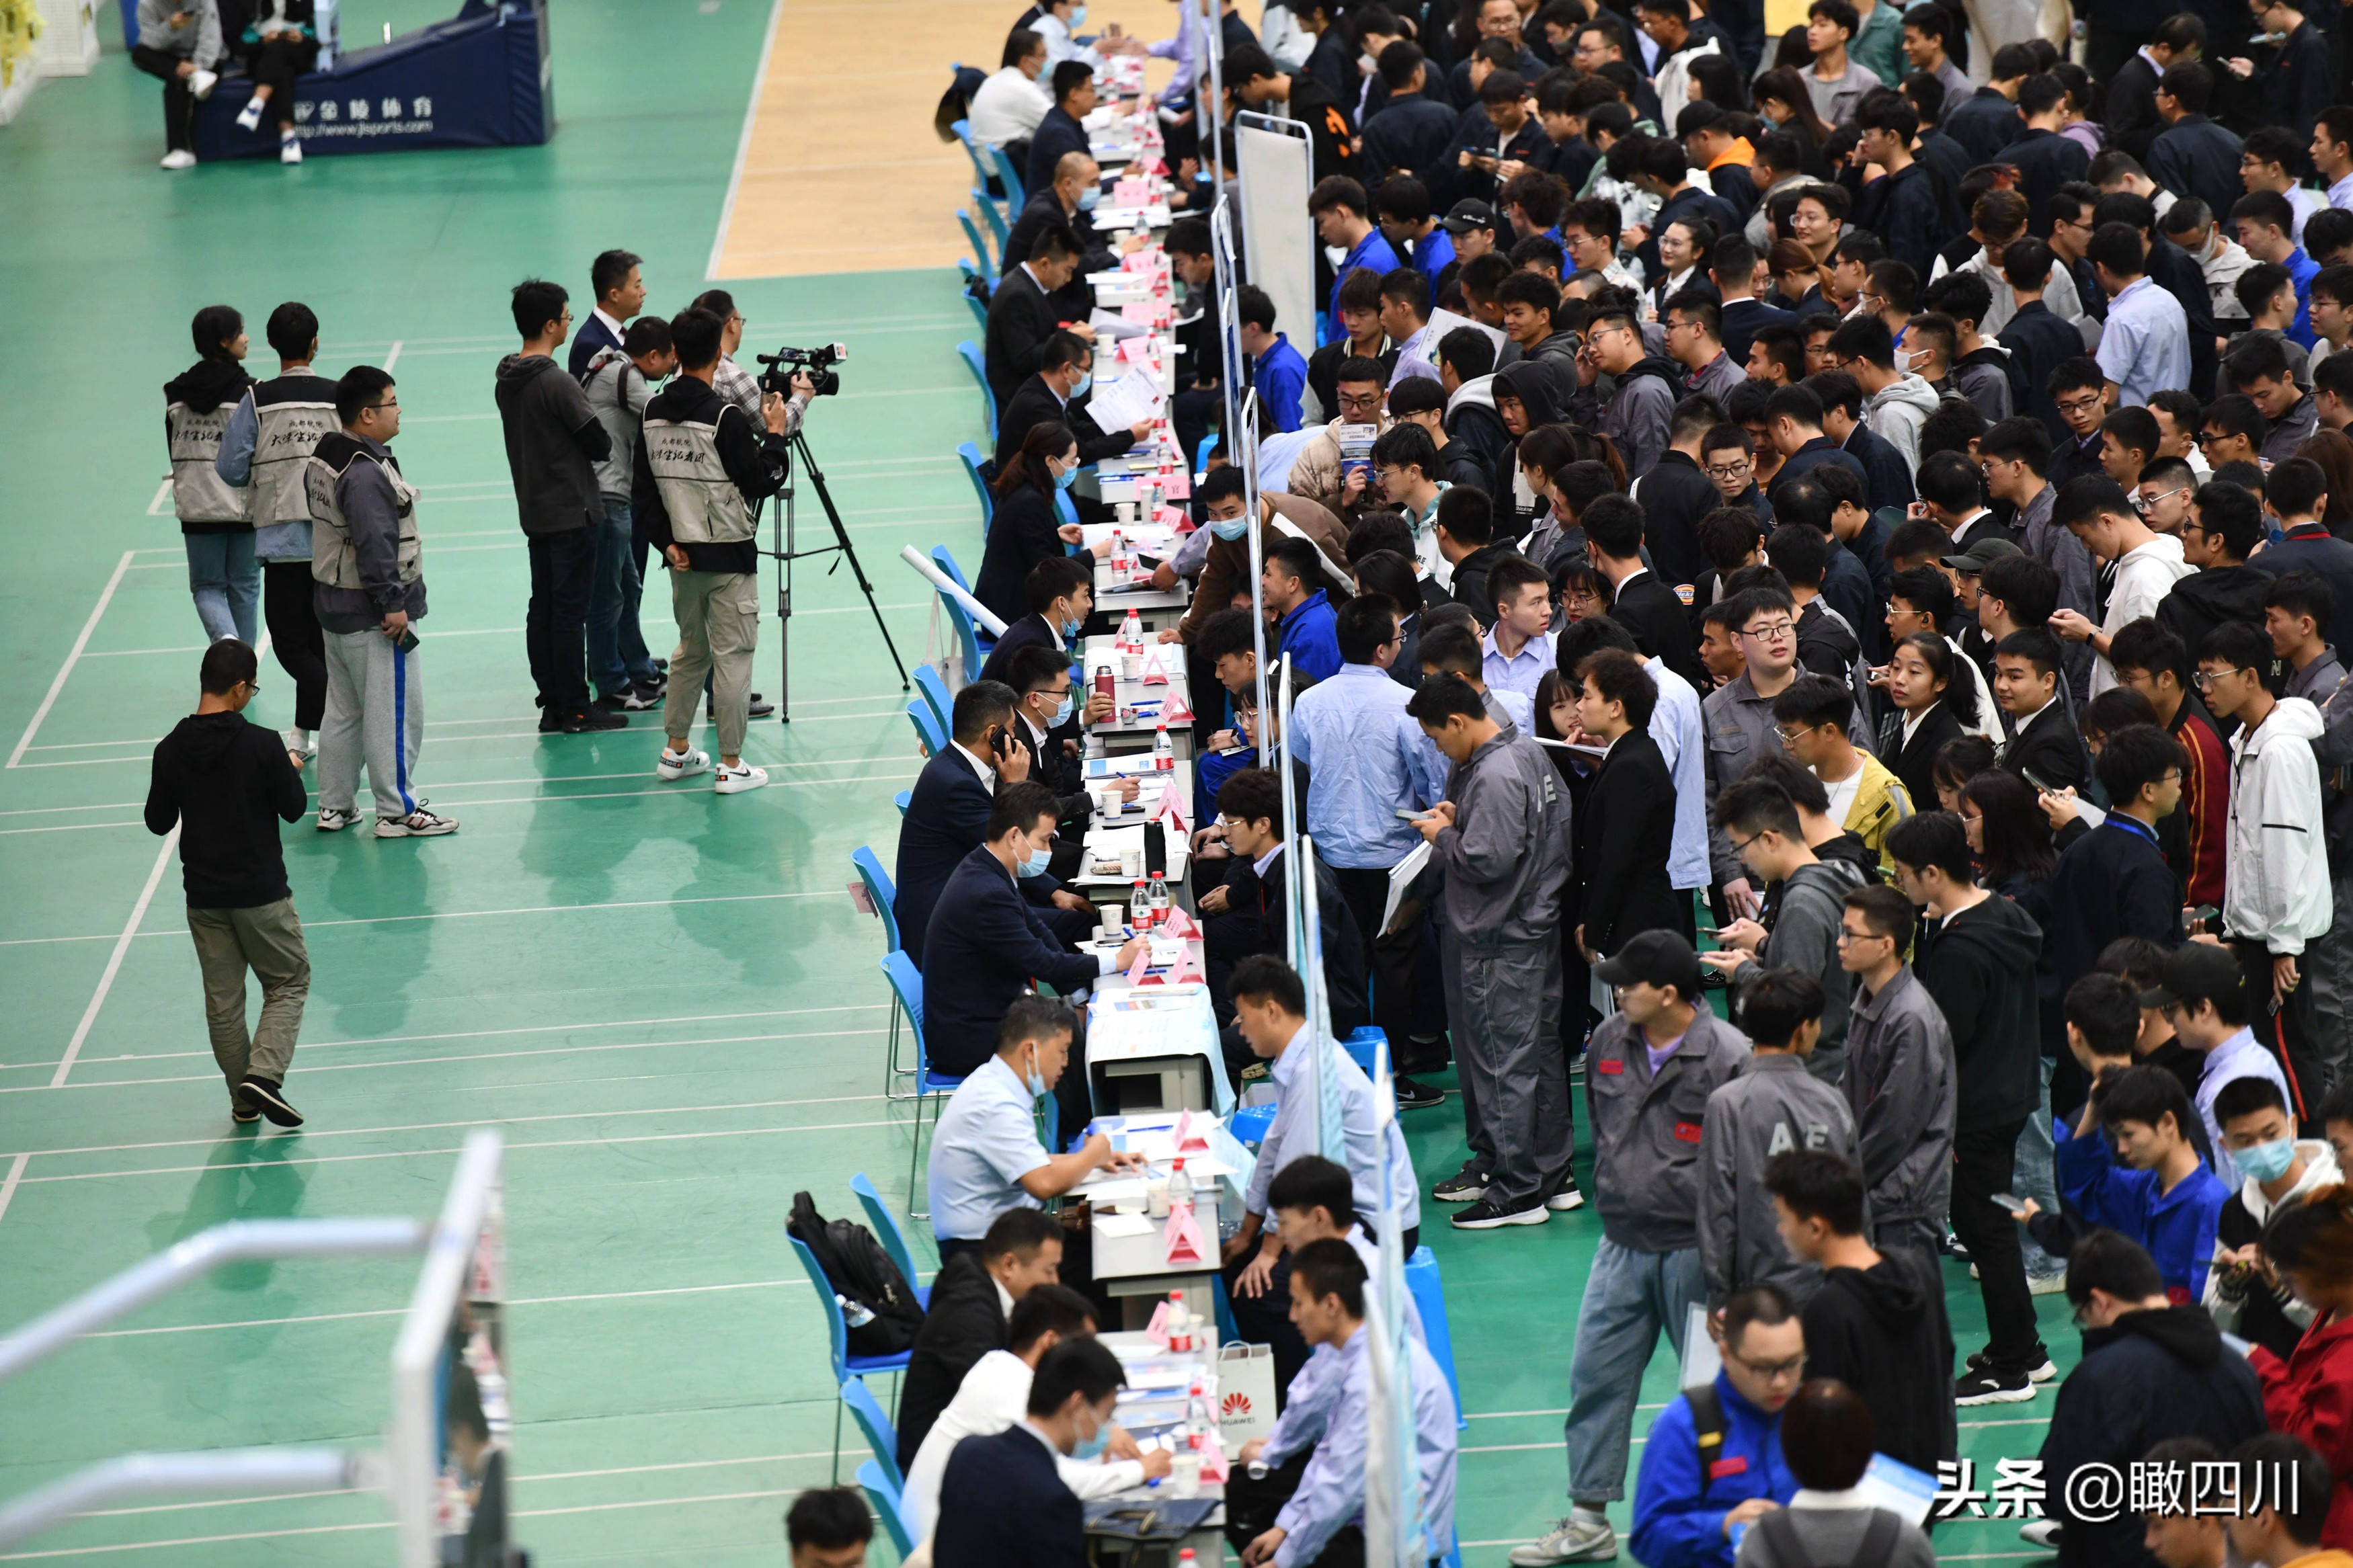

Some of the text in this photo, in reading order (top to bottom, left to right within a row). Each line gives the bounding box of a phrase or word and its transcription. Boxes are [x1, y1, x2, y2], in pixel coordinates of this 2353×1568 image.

[320, 97, 432, 120] 金陵体育
[1220, 1417, 1255, 1426] HUAWEI
